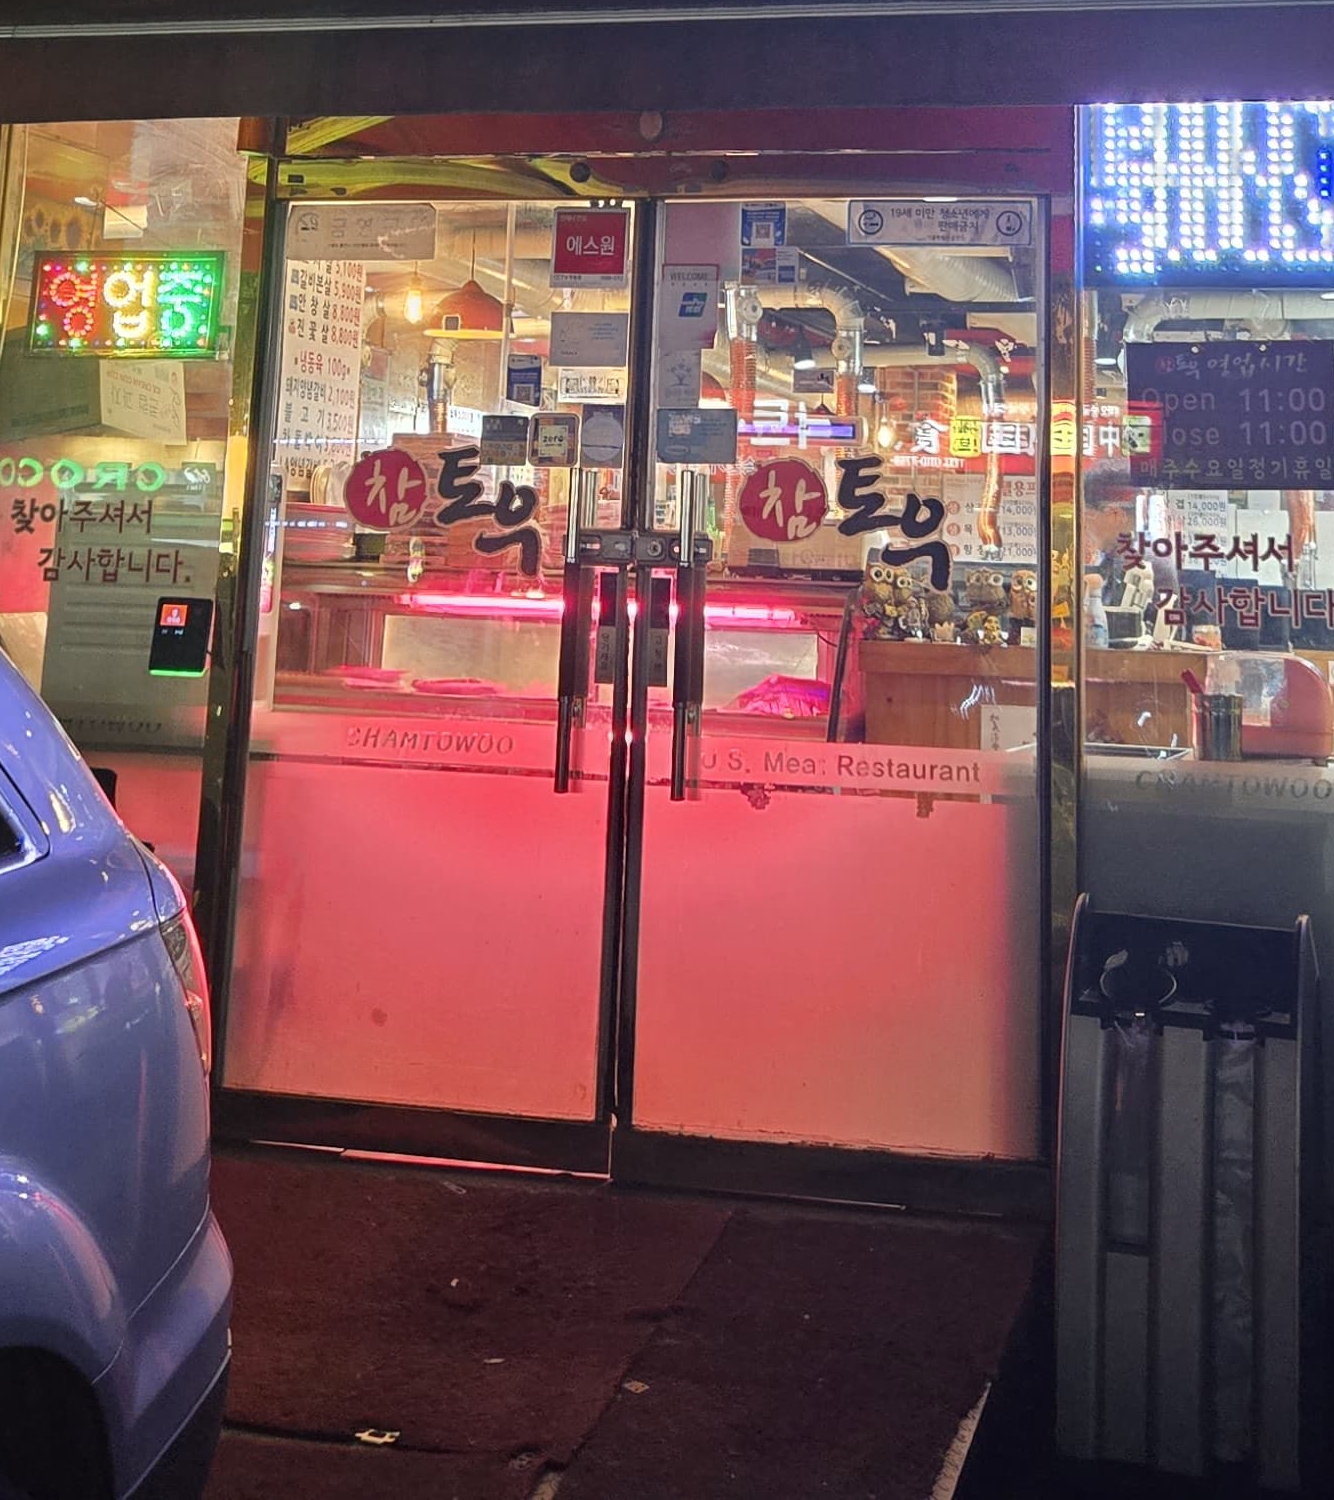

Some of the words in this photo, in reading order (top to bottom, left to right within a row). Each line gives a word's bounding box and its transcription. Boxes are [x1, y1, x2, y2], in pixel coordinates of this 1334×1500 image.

[566, 235, 616, 256] 에스원
[49, 270, 205, 339] 영업중
[1142, 387, 1217, 418] Open
[1238, 387, 1326, 413] 11:00
[1239, 419, 1328, 446] 11:00
[10, 497, 154, 535] 찾아주셔서
[38, 547, 192, 584] 감사합니다.
[1116, 530, 1295, 573] 찾아주셔서
[836, 755, 982, 783] Restaurant
